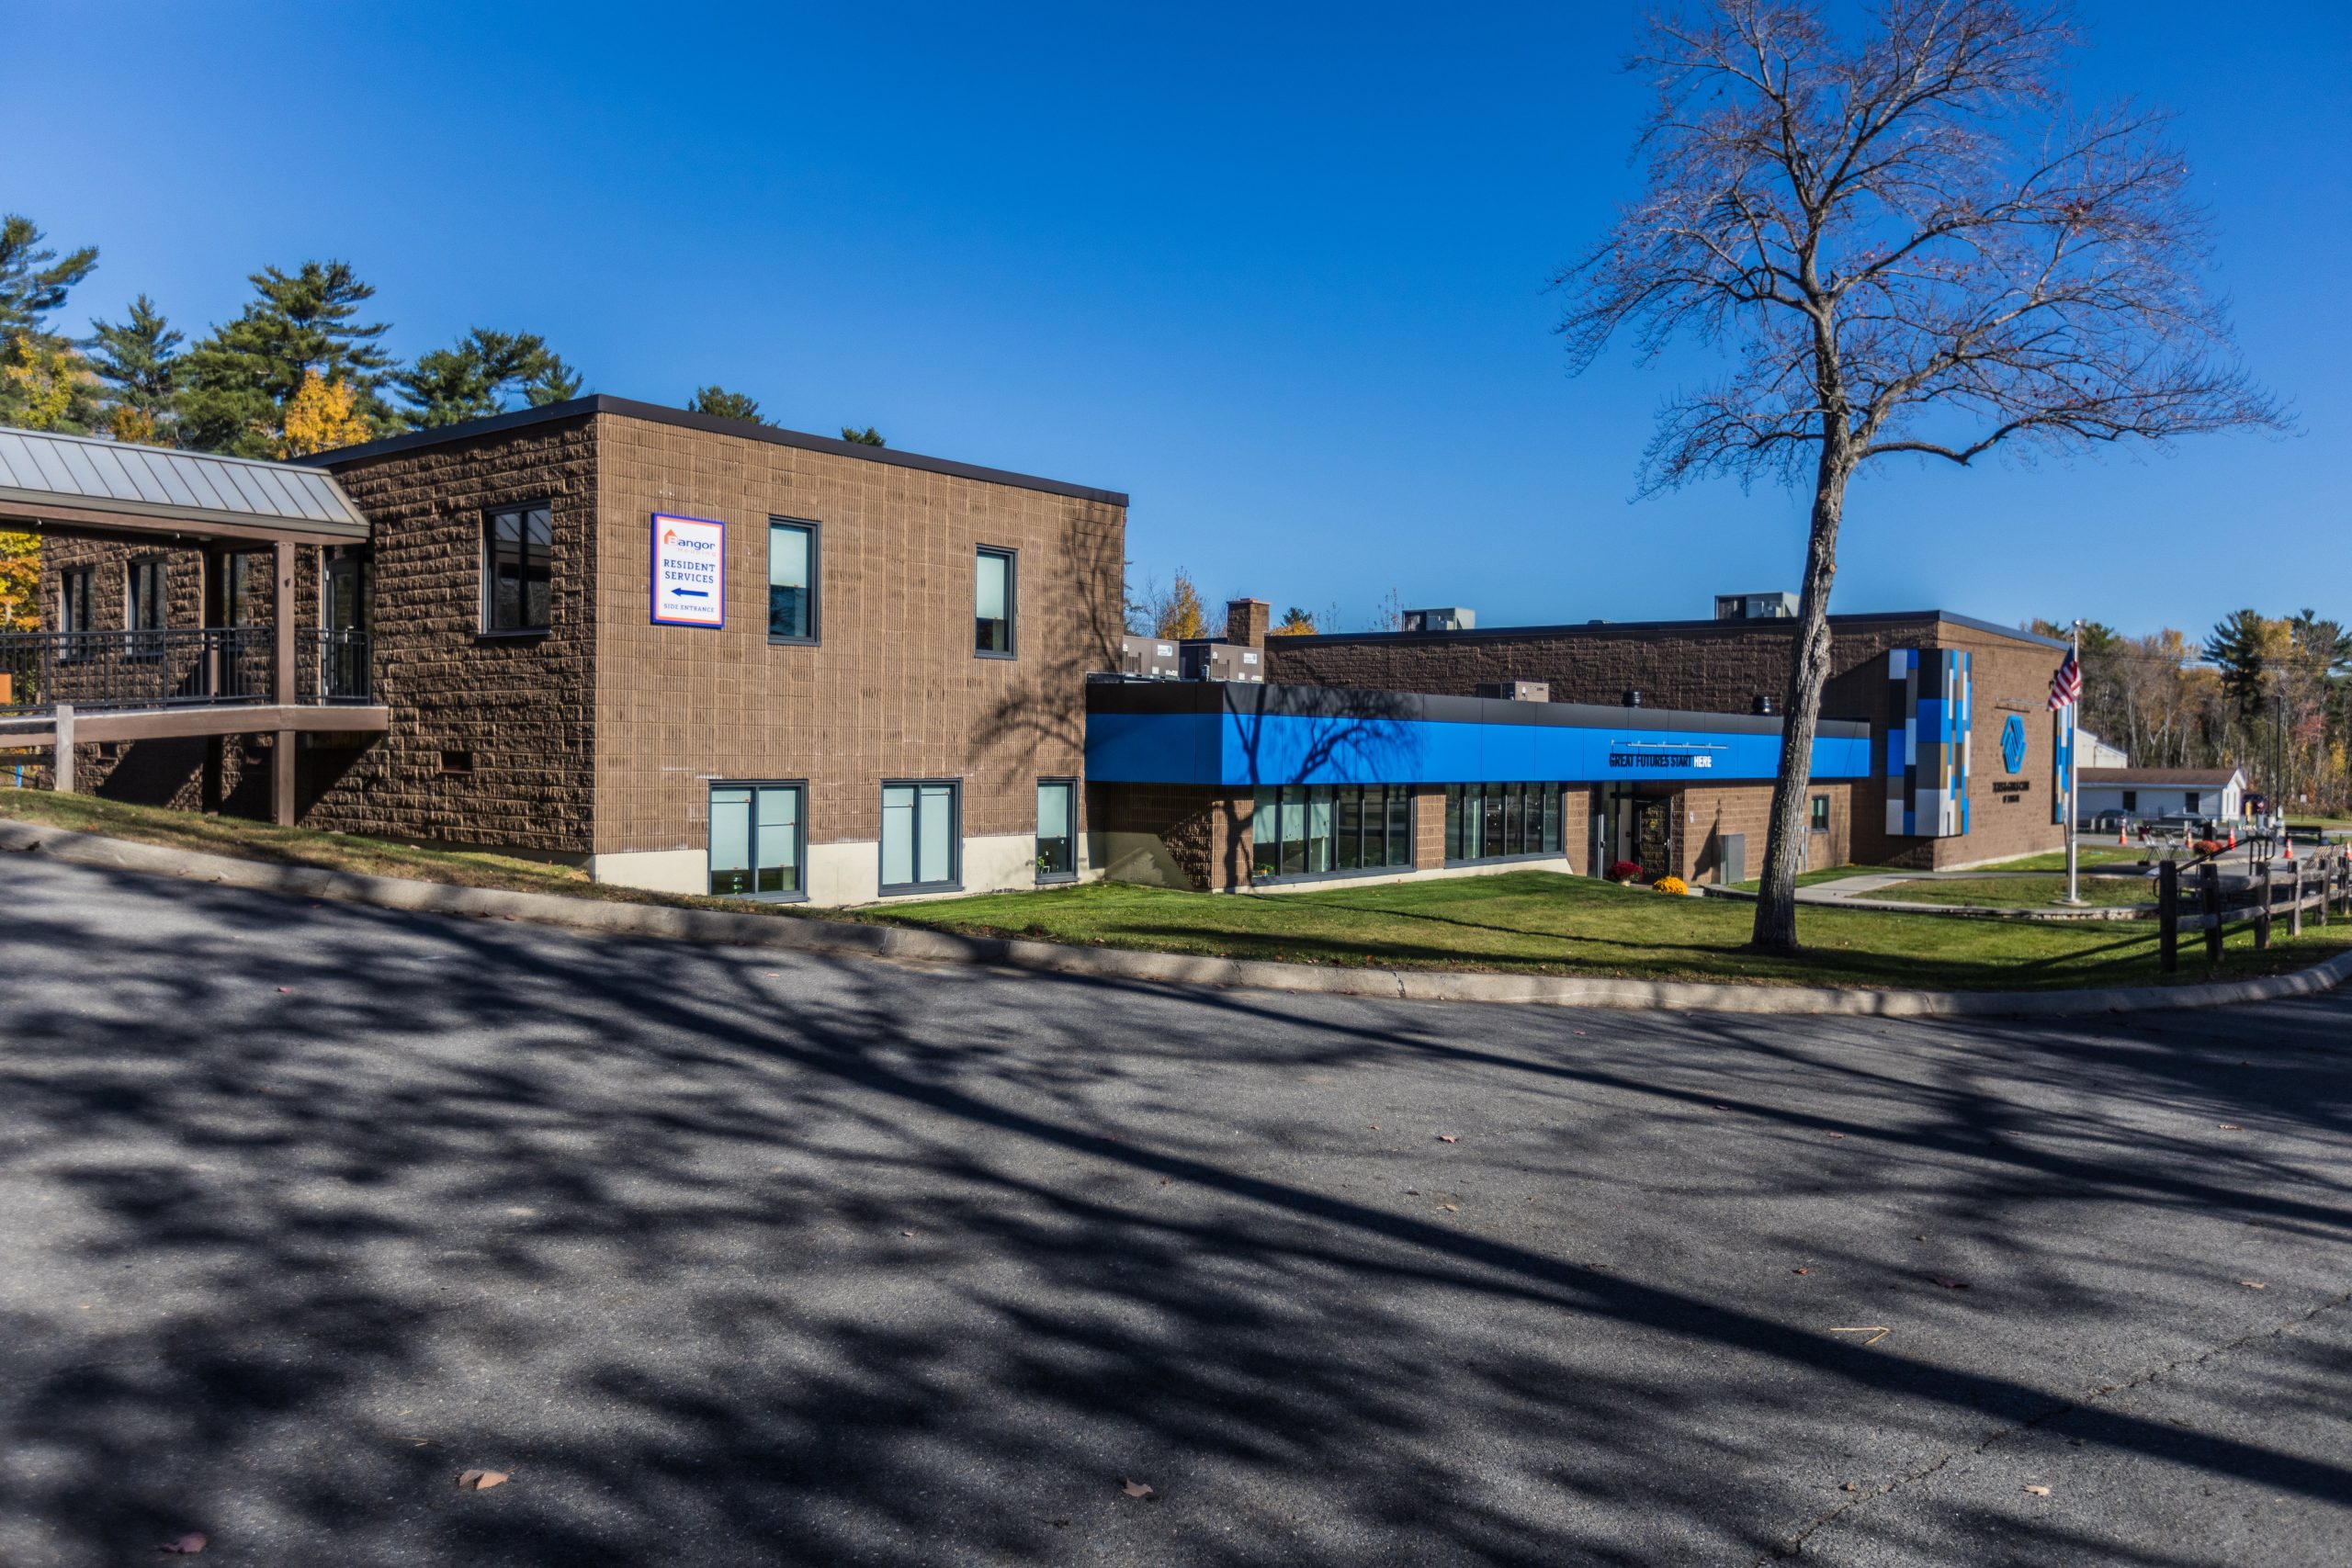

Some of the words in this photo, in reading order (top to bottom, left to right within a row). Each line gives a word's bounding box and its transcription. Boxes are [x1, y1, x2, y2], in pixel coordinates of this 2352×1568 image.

[663, 558, 716, 572] RESIDENT
[664, 570, 714, 583] SERVICES
[680, 604, 714, 613] ENTRANCE
[1610, 753, 1634, 767] GREAT
[1635, 753, 1669, 767] FUTURES
[1669, 754, 1691, 767] START
[1693, 755, 1712, 768] HERE
